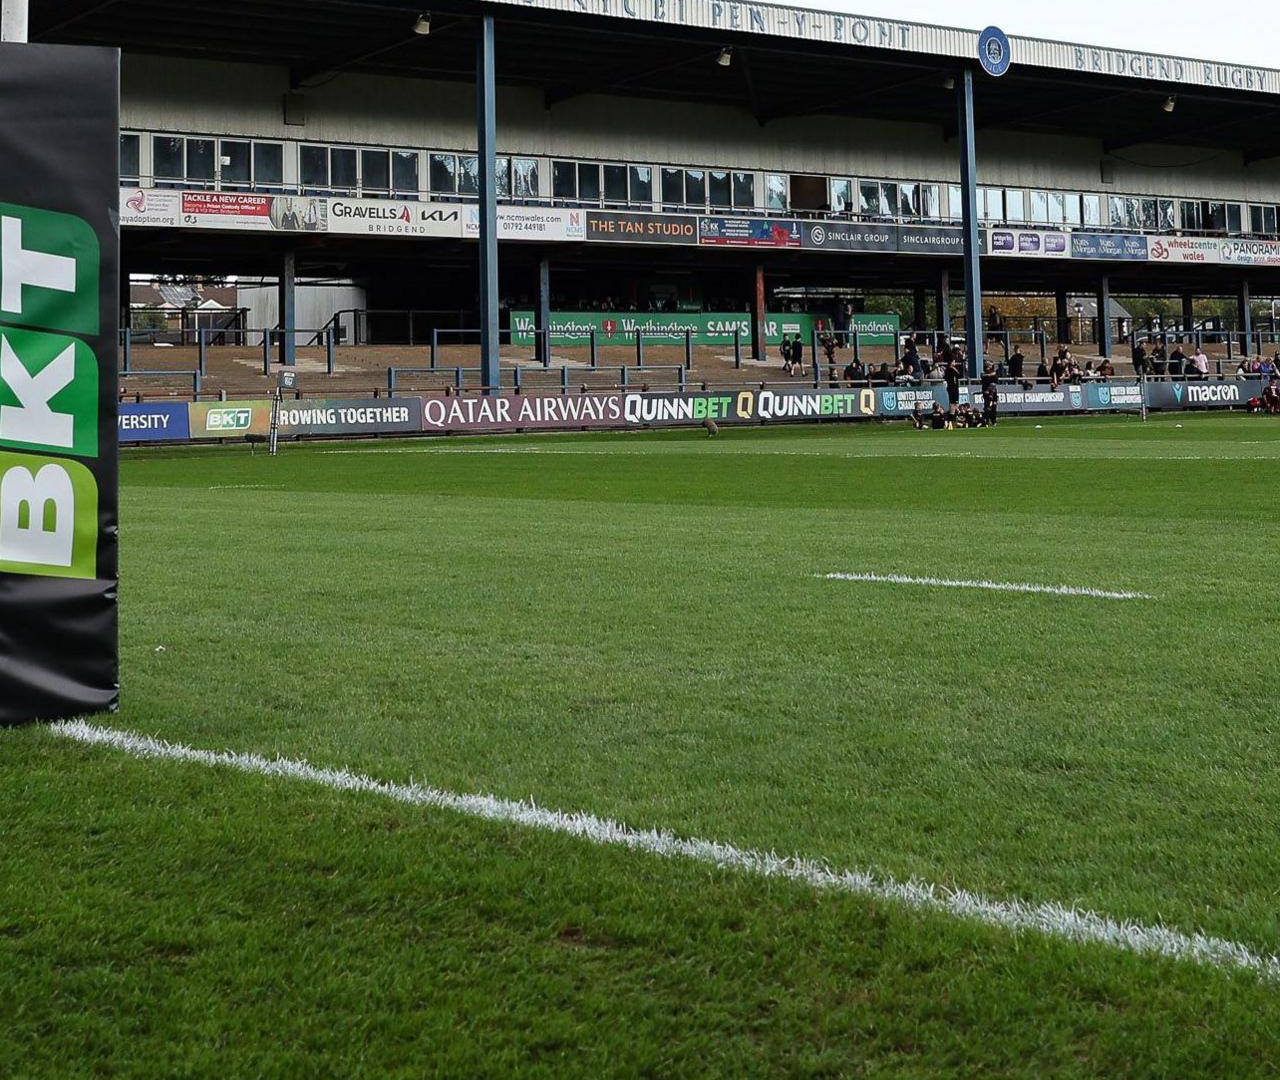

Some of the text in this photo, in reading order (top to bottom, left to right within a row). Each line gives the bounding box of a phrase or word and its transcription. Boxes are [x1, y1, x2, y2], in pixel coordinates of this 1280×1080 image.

[711, 3, 911, 49] PEN-Y-BONT
[1074, 47, 1184, 82] BRIDGEND
[1204, 64, 1267, 91] RUGBY
[184, 194, 211, 203] TACKLE
[220, 196, 237, 204] NEW
[238, 197, 267, 205] CAREER
[332, 202, 398, 220] GRAVELLS
[368, 224, 426, 234] BRIDGEND
[466, 223, 480, 231] NCM
[503, 222, 546, 232] 01792 449181
[590, 219, 694, 236] THE TAN STUDIO
[828, 232, 889, 243] SINCLAIR GROUP
[1167, 239, 1218, 250] wheelzcentre
[1182, 252, 1205, 261] wales
[515, 317, 596, 340] Woington's
[622, 318, 698, 340] Worthington's
[707, 321, 749, 336] SAM'S
[764, 323, 778, 337] AR
[849, 319, 894, 337] hington's
[0, 215, 77, 568] BKT
[897, 390, 933, 401] UNITED RUGBY
[1025, 392, 1065, 402] CHAMPIONSHIP
[1188, 384, 1239, 402] macron
[424, 396, 621, 427] QATAR AIRWAYS
[624, 389, 875, 423] QUINNBET Q QUINNBET Q
[209, 406, 410, 428] BKT ROWING TOGETHER
